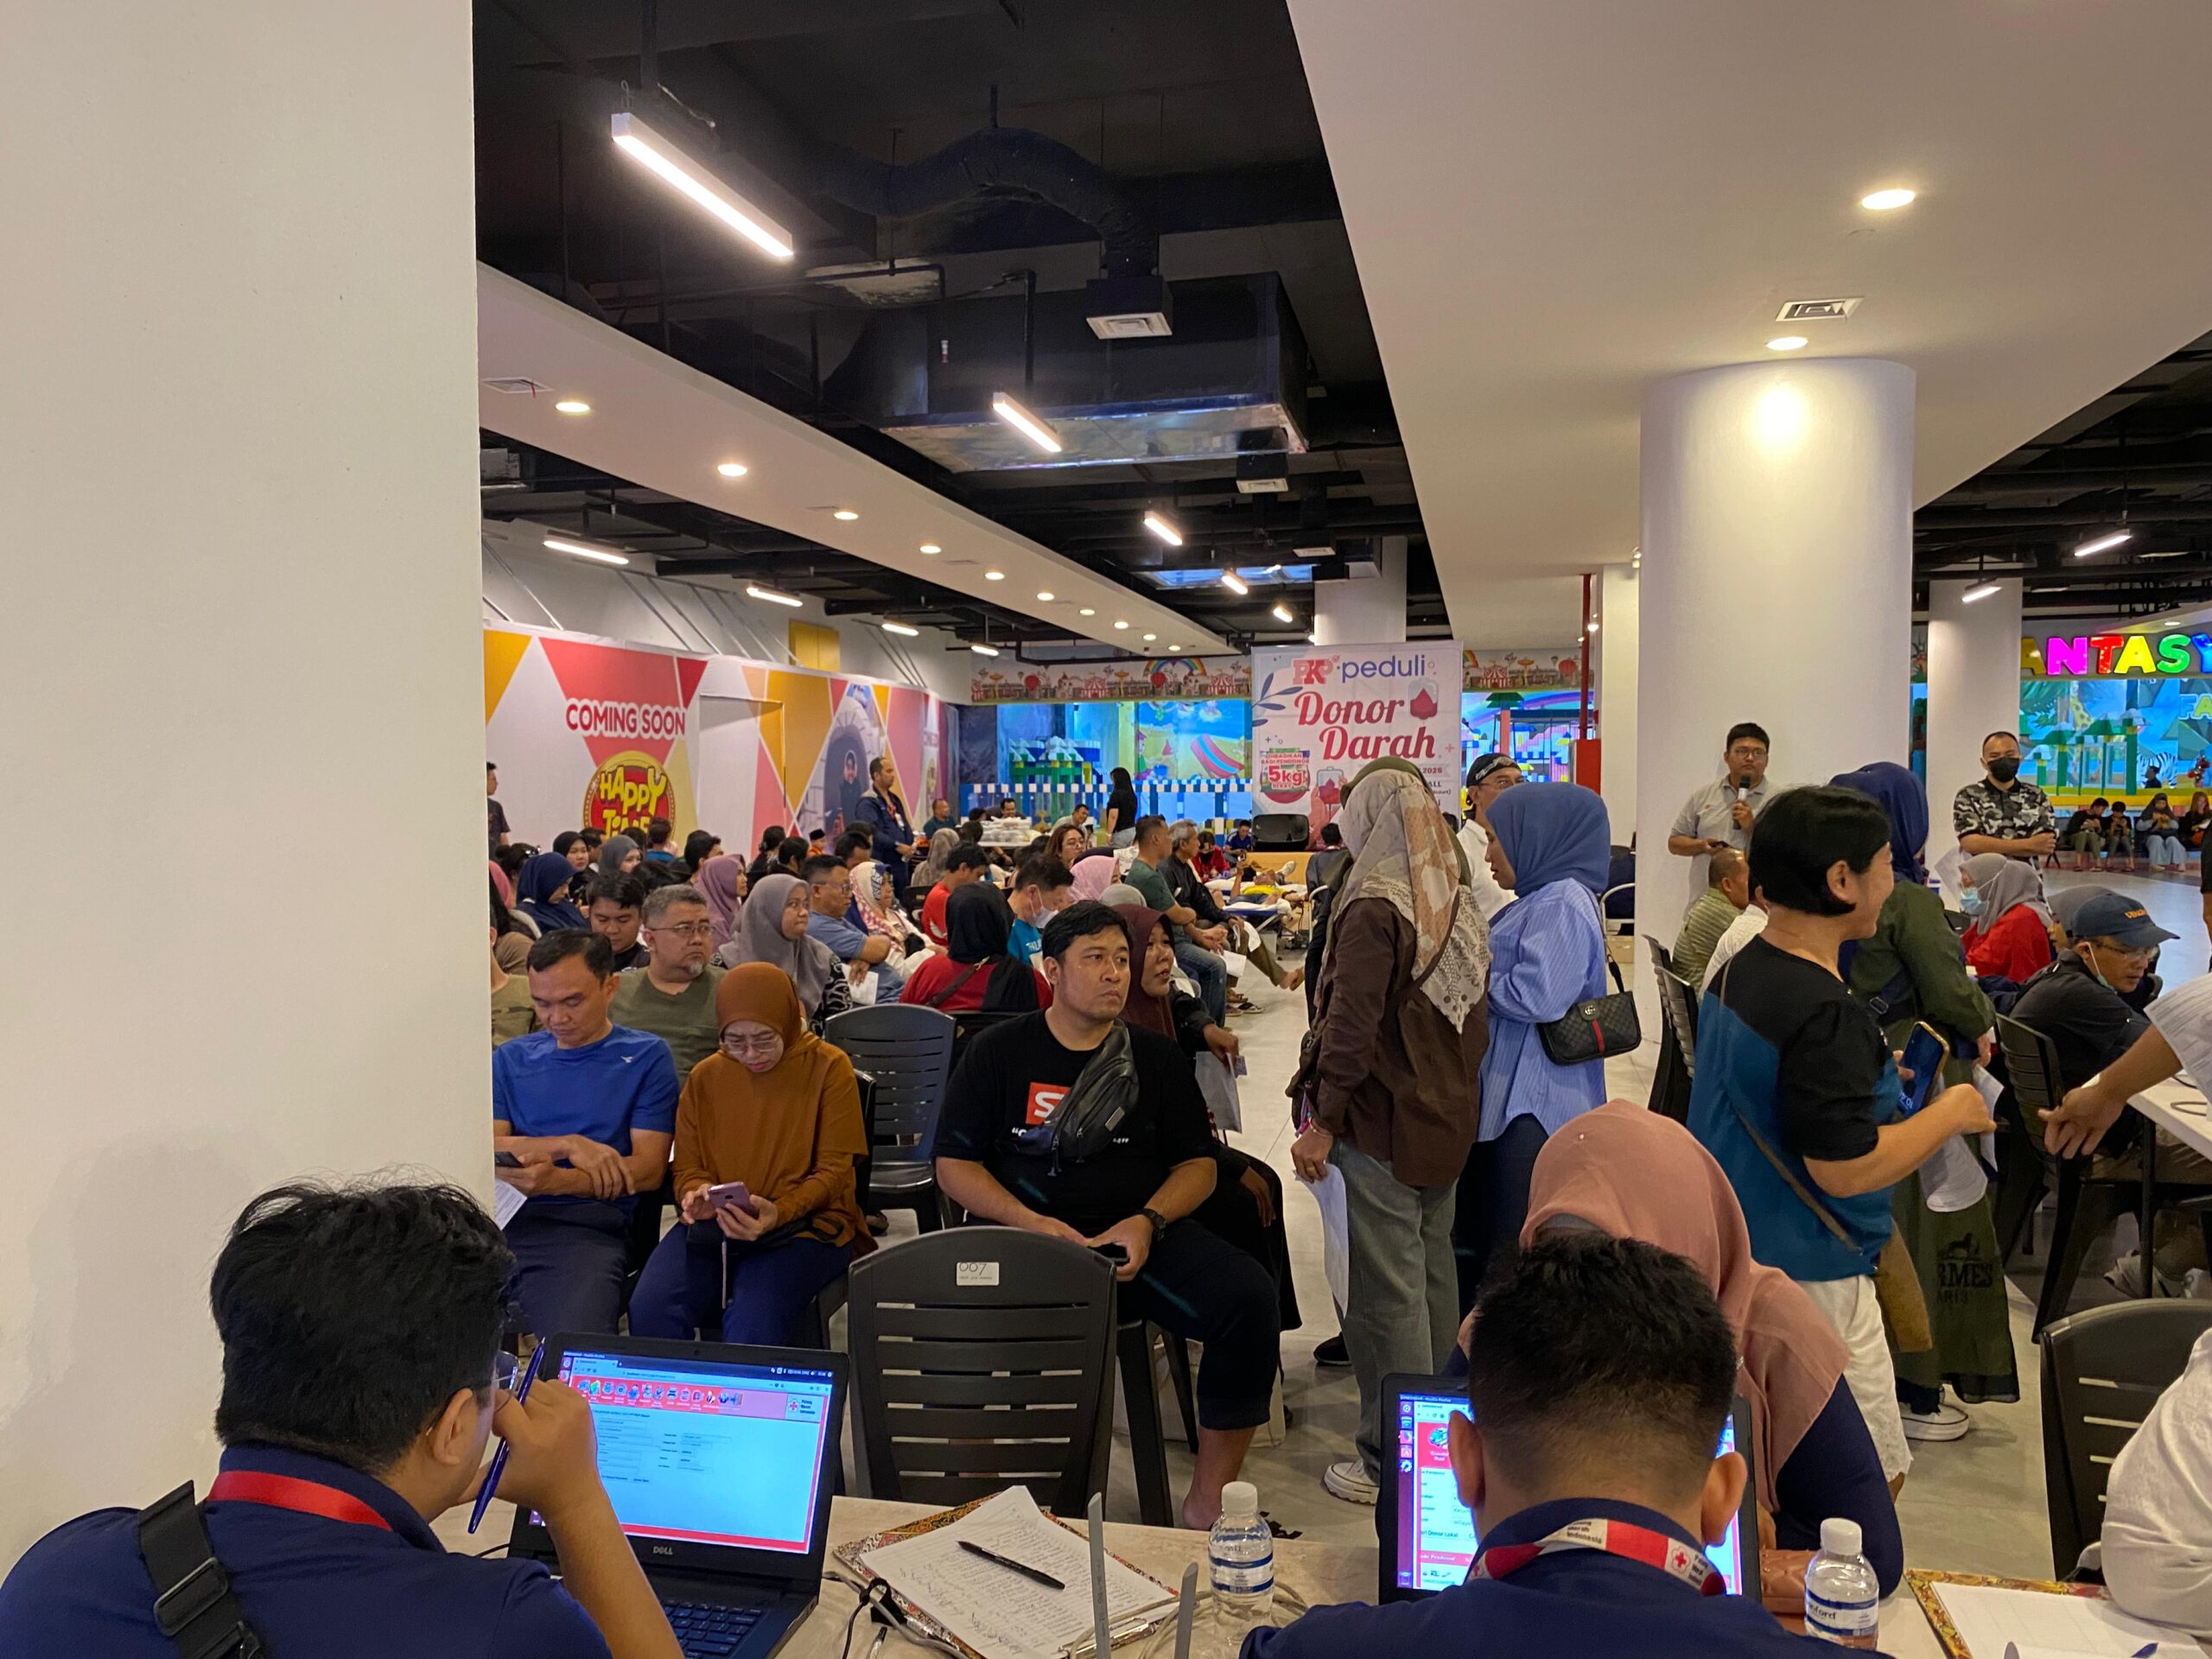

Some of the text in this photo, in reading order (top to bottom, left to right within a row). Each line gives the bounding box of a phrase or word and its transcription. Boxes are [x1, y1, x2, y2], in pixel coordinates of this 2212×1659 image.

[1342, 655, 1426, 683] peduli
[566, 703, 685, 735] COMING SOON
[1294, 691, 1405, 726] Donor
[1319, 726, 1436, 760] Darah
[600, 766, 667, 816] HAPPY
[652, 1546, 673, 1555] DELL
